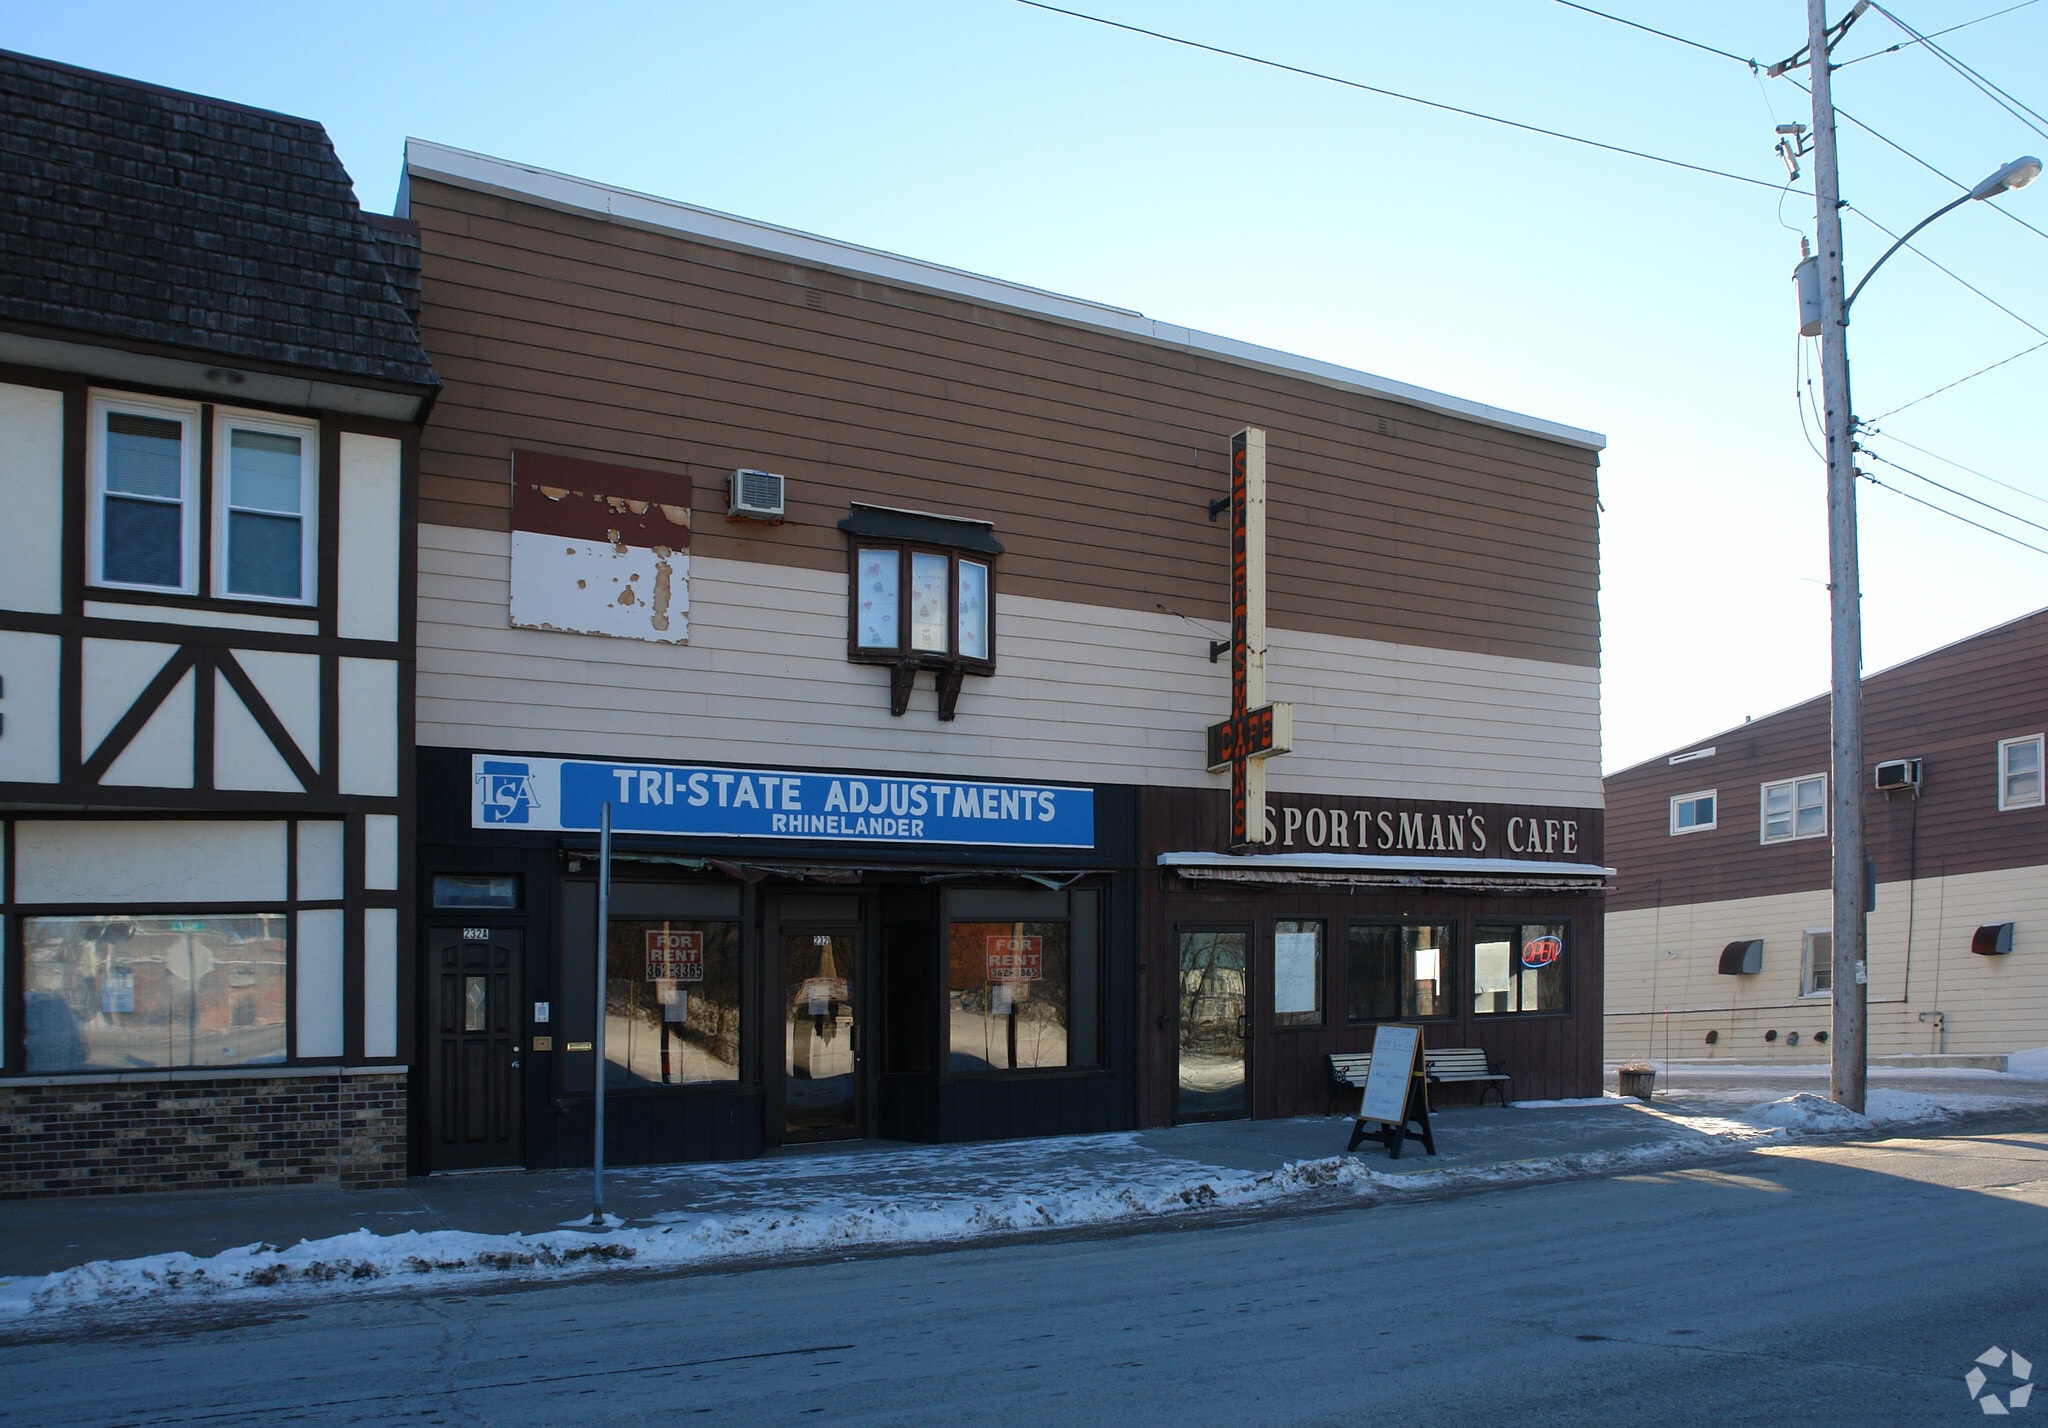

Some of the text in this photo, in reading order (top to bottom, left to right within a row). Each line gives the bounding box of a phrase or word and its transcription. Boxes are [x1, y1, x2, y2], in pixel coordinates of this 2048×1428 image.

[1233, 448, 1247, 836] SPORTSMANS
[1221, 710, 1272, 761] CAFE
[475, 772, 541, 822] TSA
[612, 769, 1056, 822] TRI-STATE ADJUSTMENTS
[772, 813, 924, 838] RHINELANDER
[1264, 805, 1578, 854] SPORTSMAN'S CAFE
[464, 928, 488, 940] 232A
[656, 935, 692, 948] FOR
[814, 935, 828, 946] 232
[996, 939, 1033, 951] FOR
[1523, 941, 1559, 962] OPEN
[651, 949, 698, 962] RENT
[989, 954, 1040, 966] RENT
[647, 963, 702, 977] 362-3365
